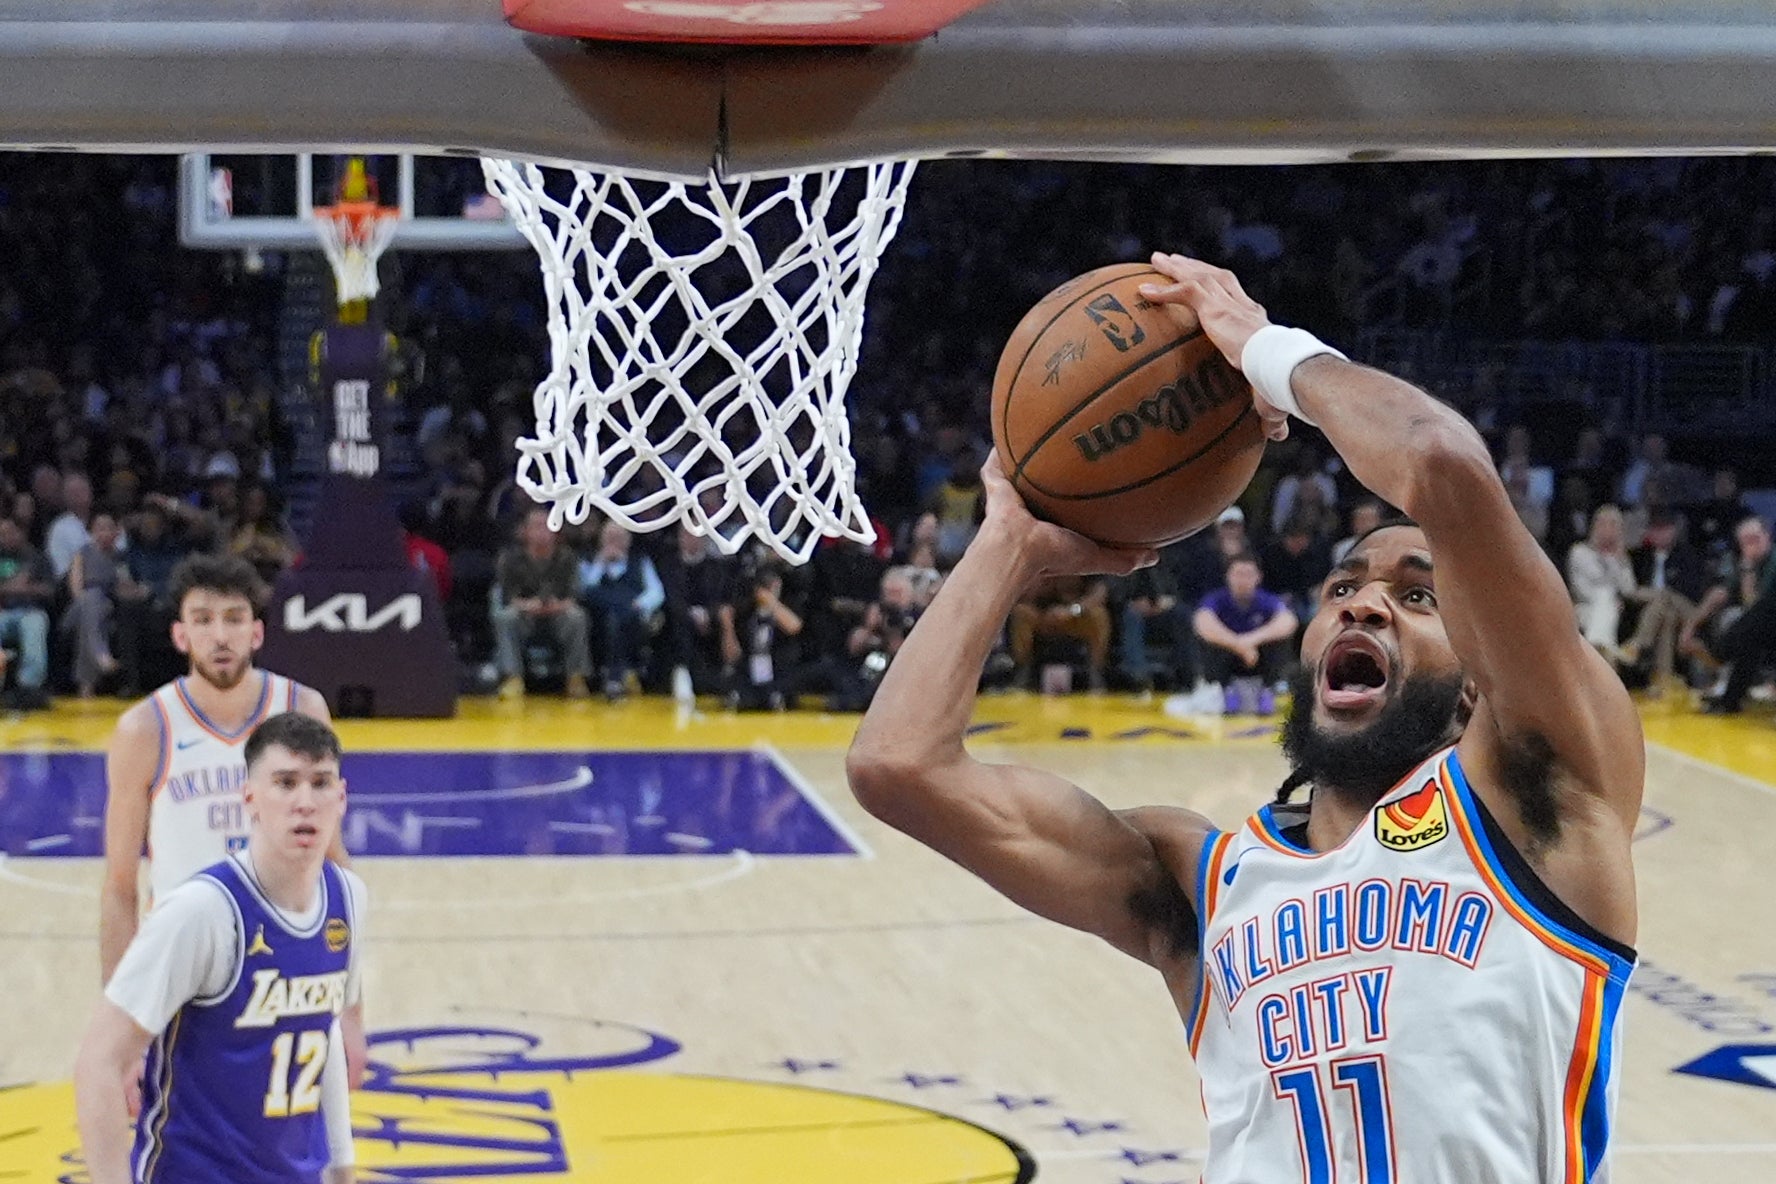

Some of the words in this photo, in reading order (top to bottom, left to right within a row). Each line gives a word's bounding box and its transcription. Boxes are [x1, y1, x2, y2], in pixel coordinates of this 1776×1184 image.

[284, 593, 422, 632] KIA
[208, 802, 242, 830] CIT
[1257, 966, 1393, 1068] CITY
[264, 1030, 328, 1118] 12
